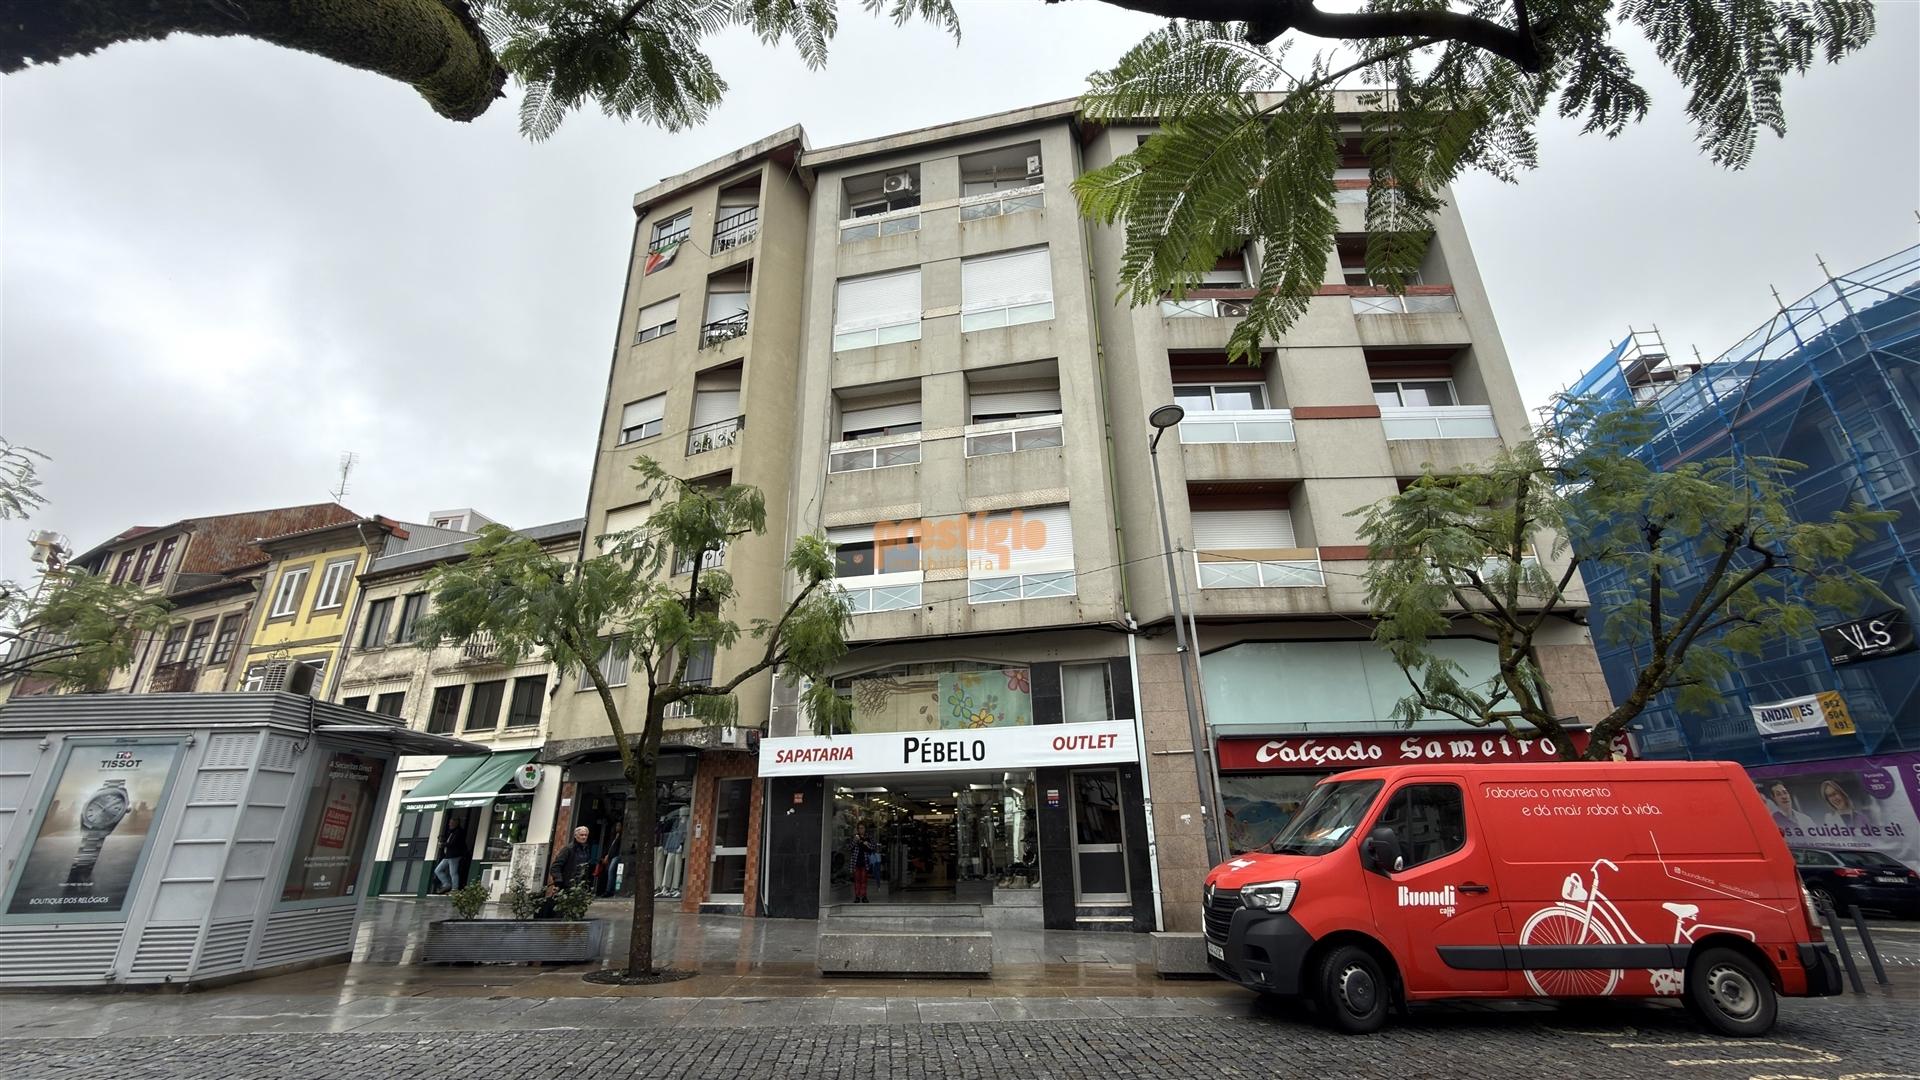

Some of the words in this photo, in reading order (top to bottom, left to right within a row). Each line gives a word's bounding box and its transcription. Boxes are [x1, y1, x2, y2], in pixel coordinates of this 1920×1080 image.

[1837, 620, 1891, 650] VLS
[775, 746, 854, 764] SAPATARIA
[903, 736, 985, 764] PÉBELO
[1052, 733, 1117, 752] OUTLET
[1256, 739, 1383, 766] Calçado
[1400, 733, 1557, 760] Sameiro
[101, 759, 143, 769] TISSOT
[1540, 789, 1550, 798] o
[1552, 787, 1611, 798] momento
[1522, 807, 1531, 816] e
[1533, 804, 1551, 816] dá
[1553, 804, 1582, 816] mais
[1586, 804, 1619, 816] sabor
[1795, 827, 1805, 837] a
[1808, 823, 1857, 838] cuidar
[1860, 823, 1881, 837] de
[1885, 821, 1905, 837] si!
[29, 897, 63, 905] BOUTIQUE
[63, 896, 77, 904] DOS
[1397, 885, 1456, 907] Buondi
